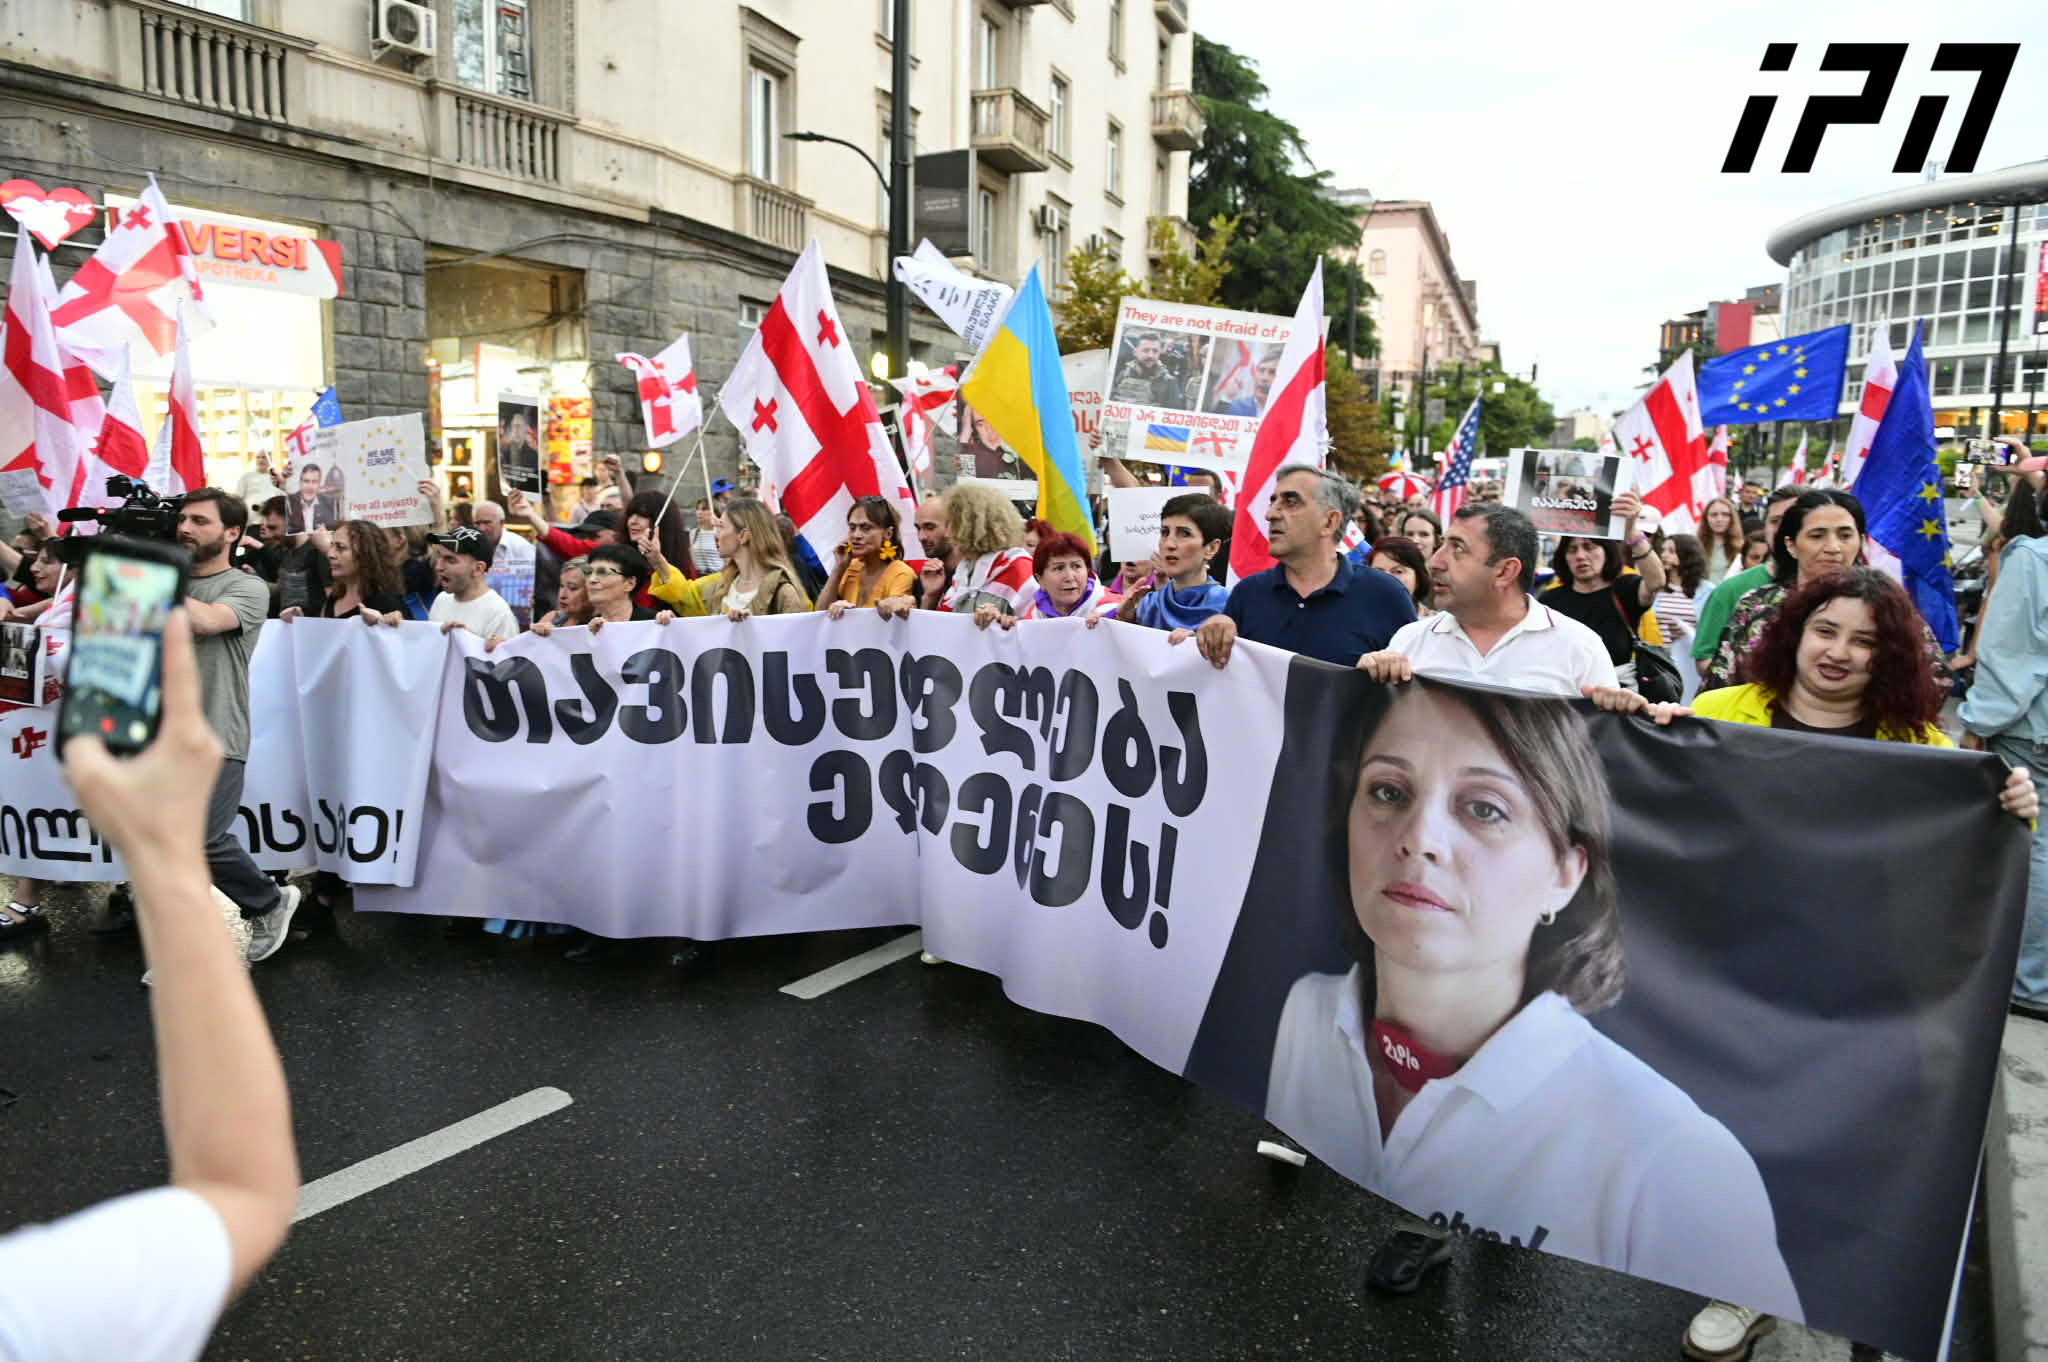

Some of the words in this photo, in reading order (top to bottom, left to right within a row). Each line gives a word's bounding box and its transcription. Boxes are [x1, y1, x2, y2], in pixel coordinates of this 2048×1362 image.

[180, 219, 308, 271] VERSI
[1124, 307, 1157, 324] They
[1161, 315, 1184, 328] are
[1187, 318, 1211, 331] not
[1215, 320, 1257, 336] afraid
[1261, 326, 1277, 338] of
[463, 647, 1208, 818] თავისუფლება
[807, 749, 1180, 950] ელენეს!
